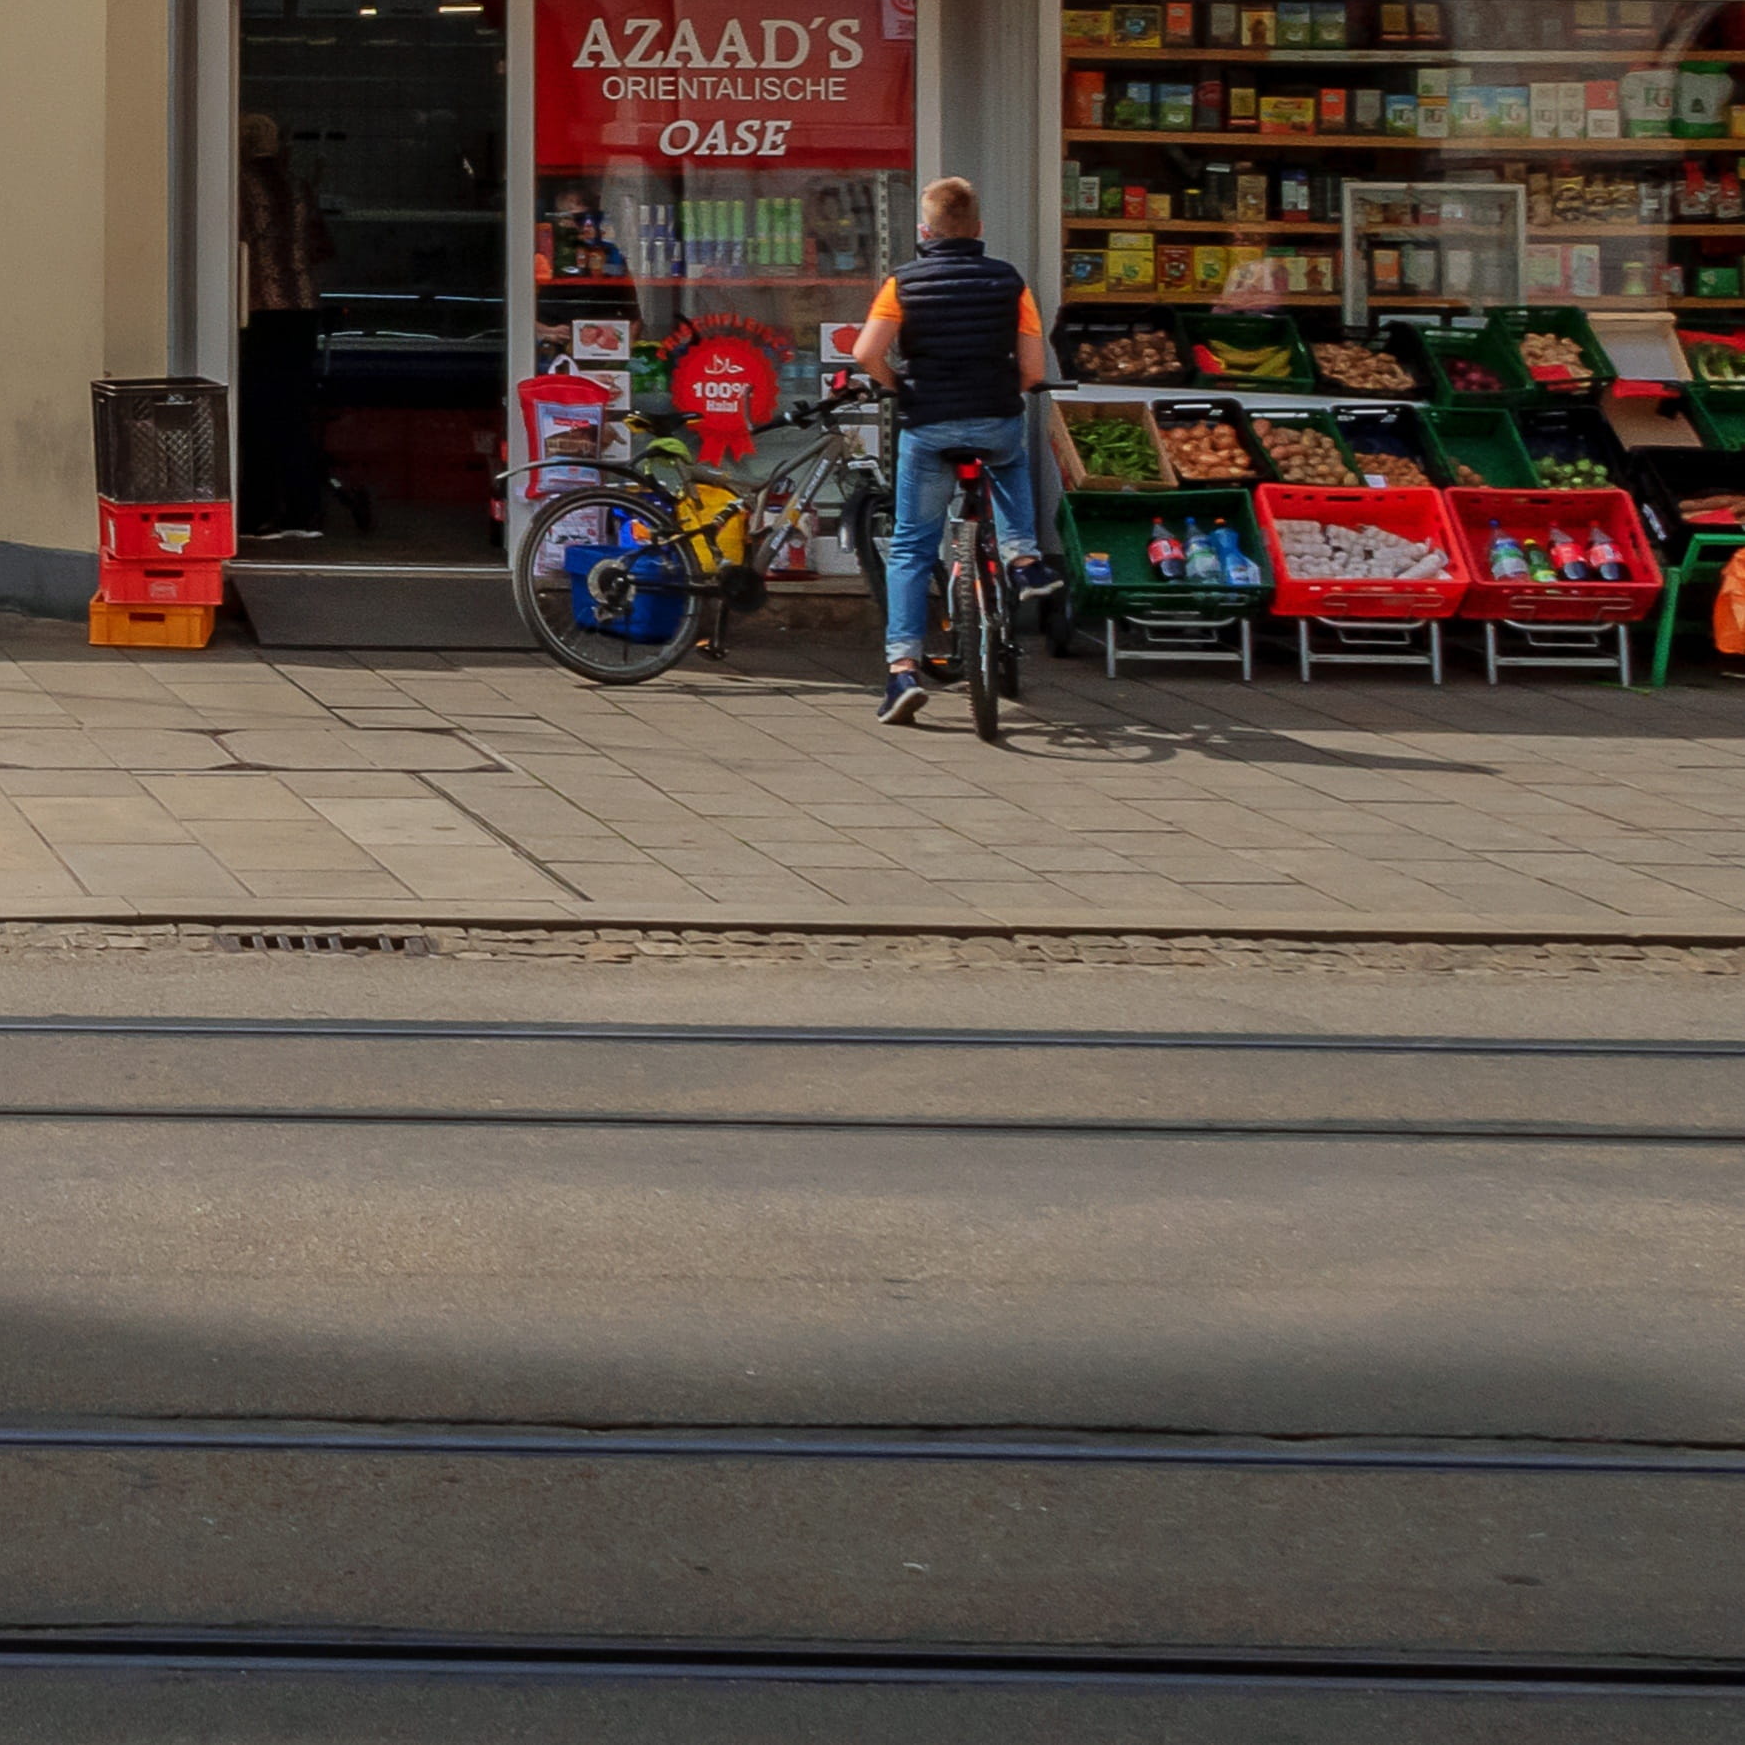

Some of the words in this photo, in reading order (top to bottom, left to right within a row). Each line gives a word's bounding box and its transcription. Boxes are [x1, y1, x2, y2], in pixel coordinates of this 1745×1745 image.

[601, 75, 848, 102] ORIENTALISCHE
[659, 119, 793, 156] OASE
[692, 382, 754, 399] 100%
